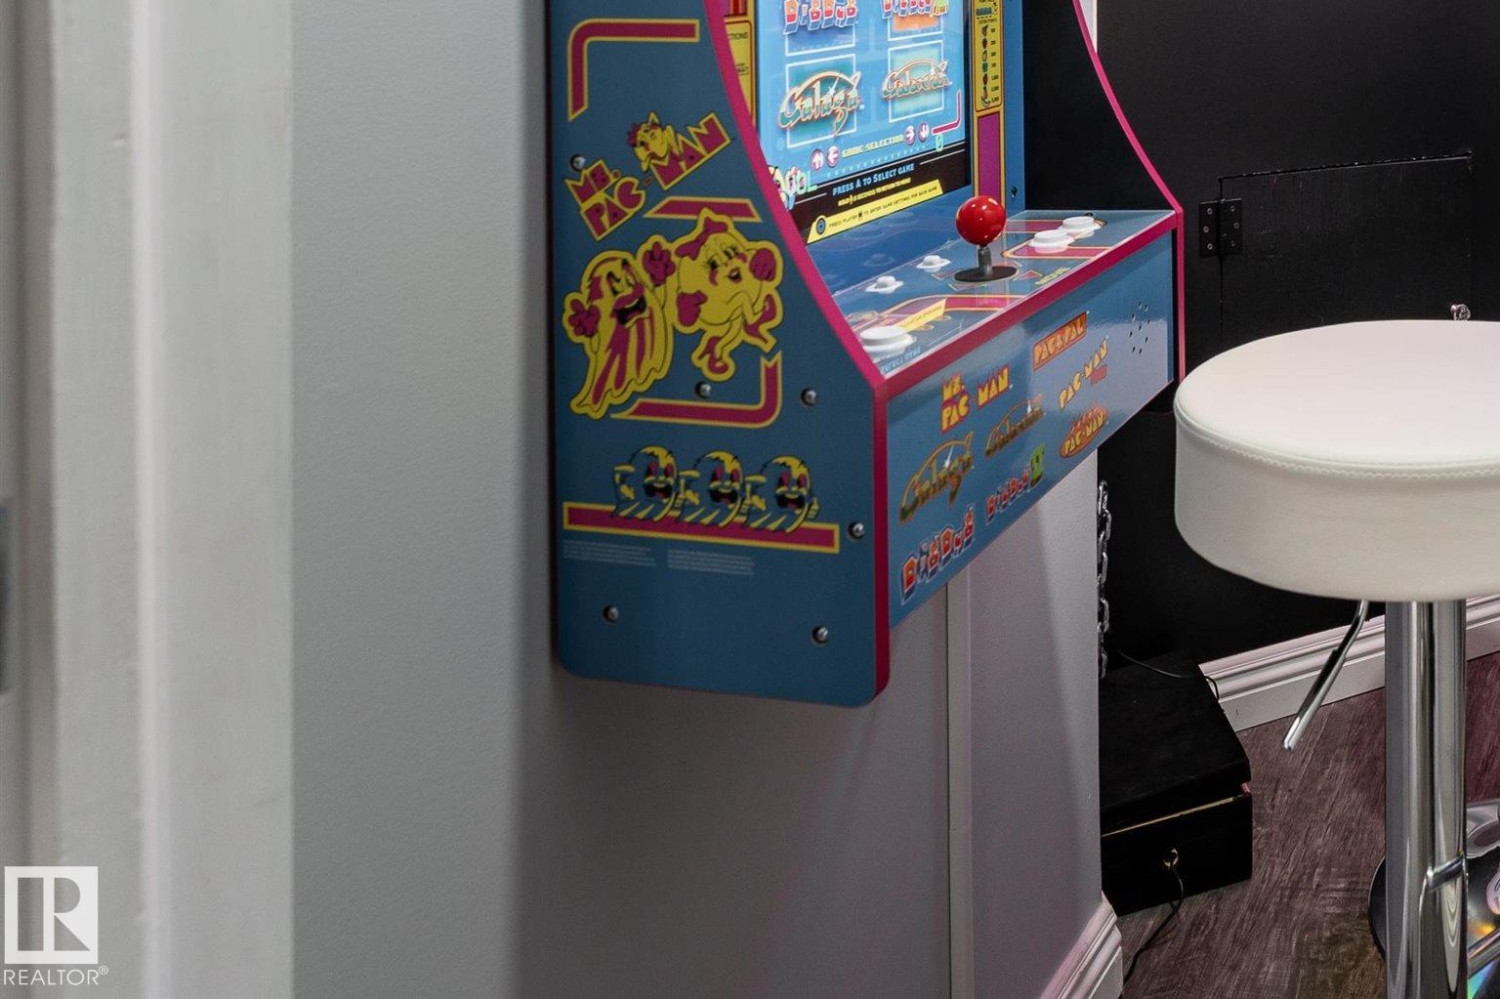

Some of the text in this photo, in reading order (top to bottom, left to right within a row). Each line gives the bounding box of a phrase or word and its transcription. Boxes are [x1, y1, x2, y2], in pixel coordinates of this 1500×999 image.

[832, 182, 854, 196] PRESS
[873, 168, 897, 184] SELECT
[941, 364, 1011, 433] PAC-MAN
